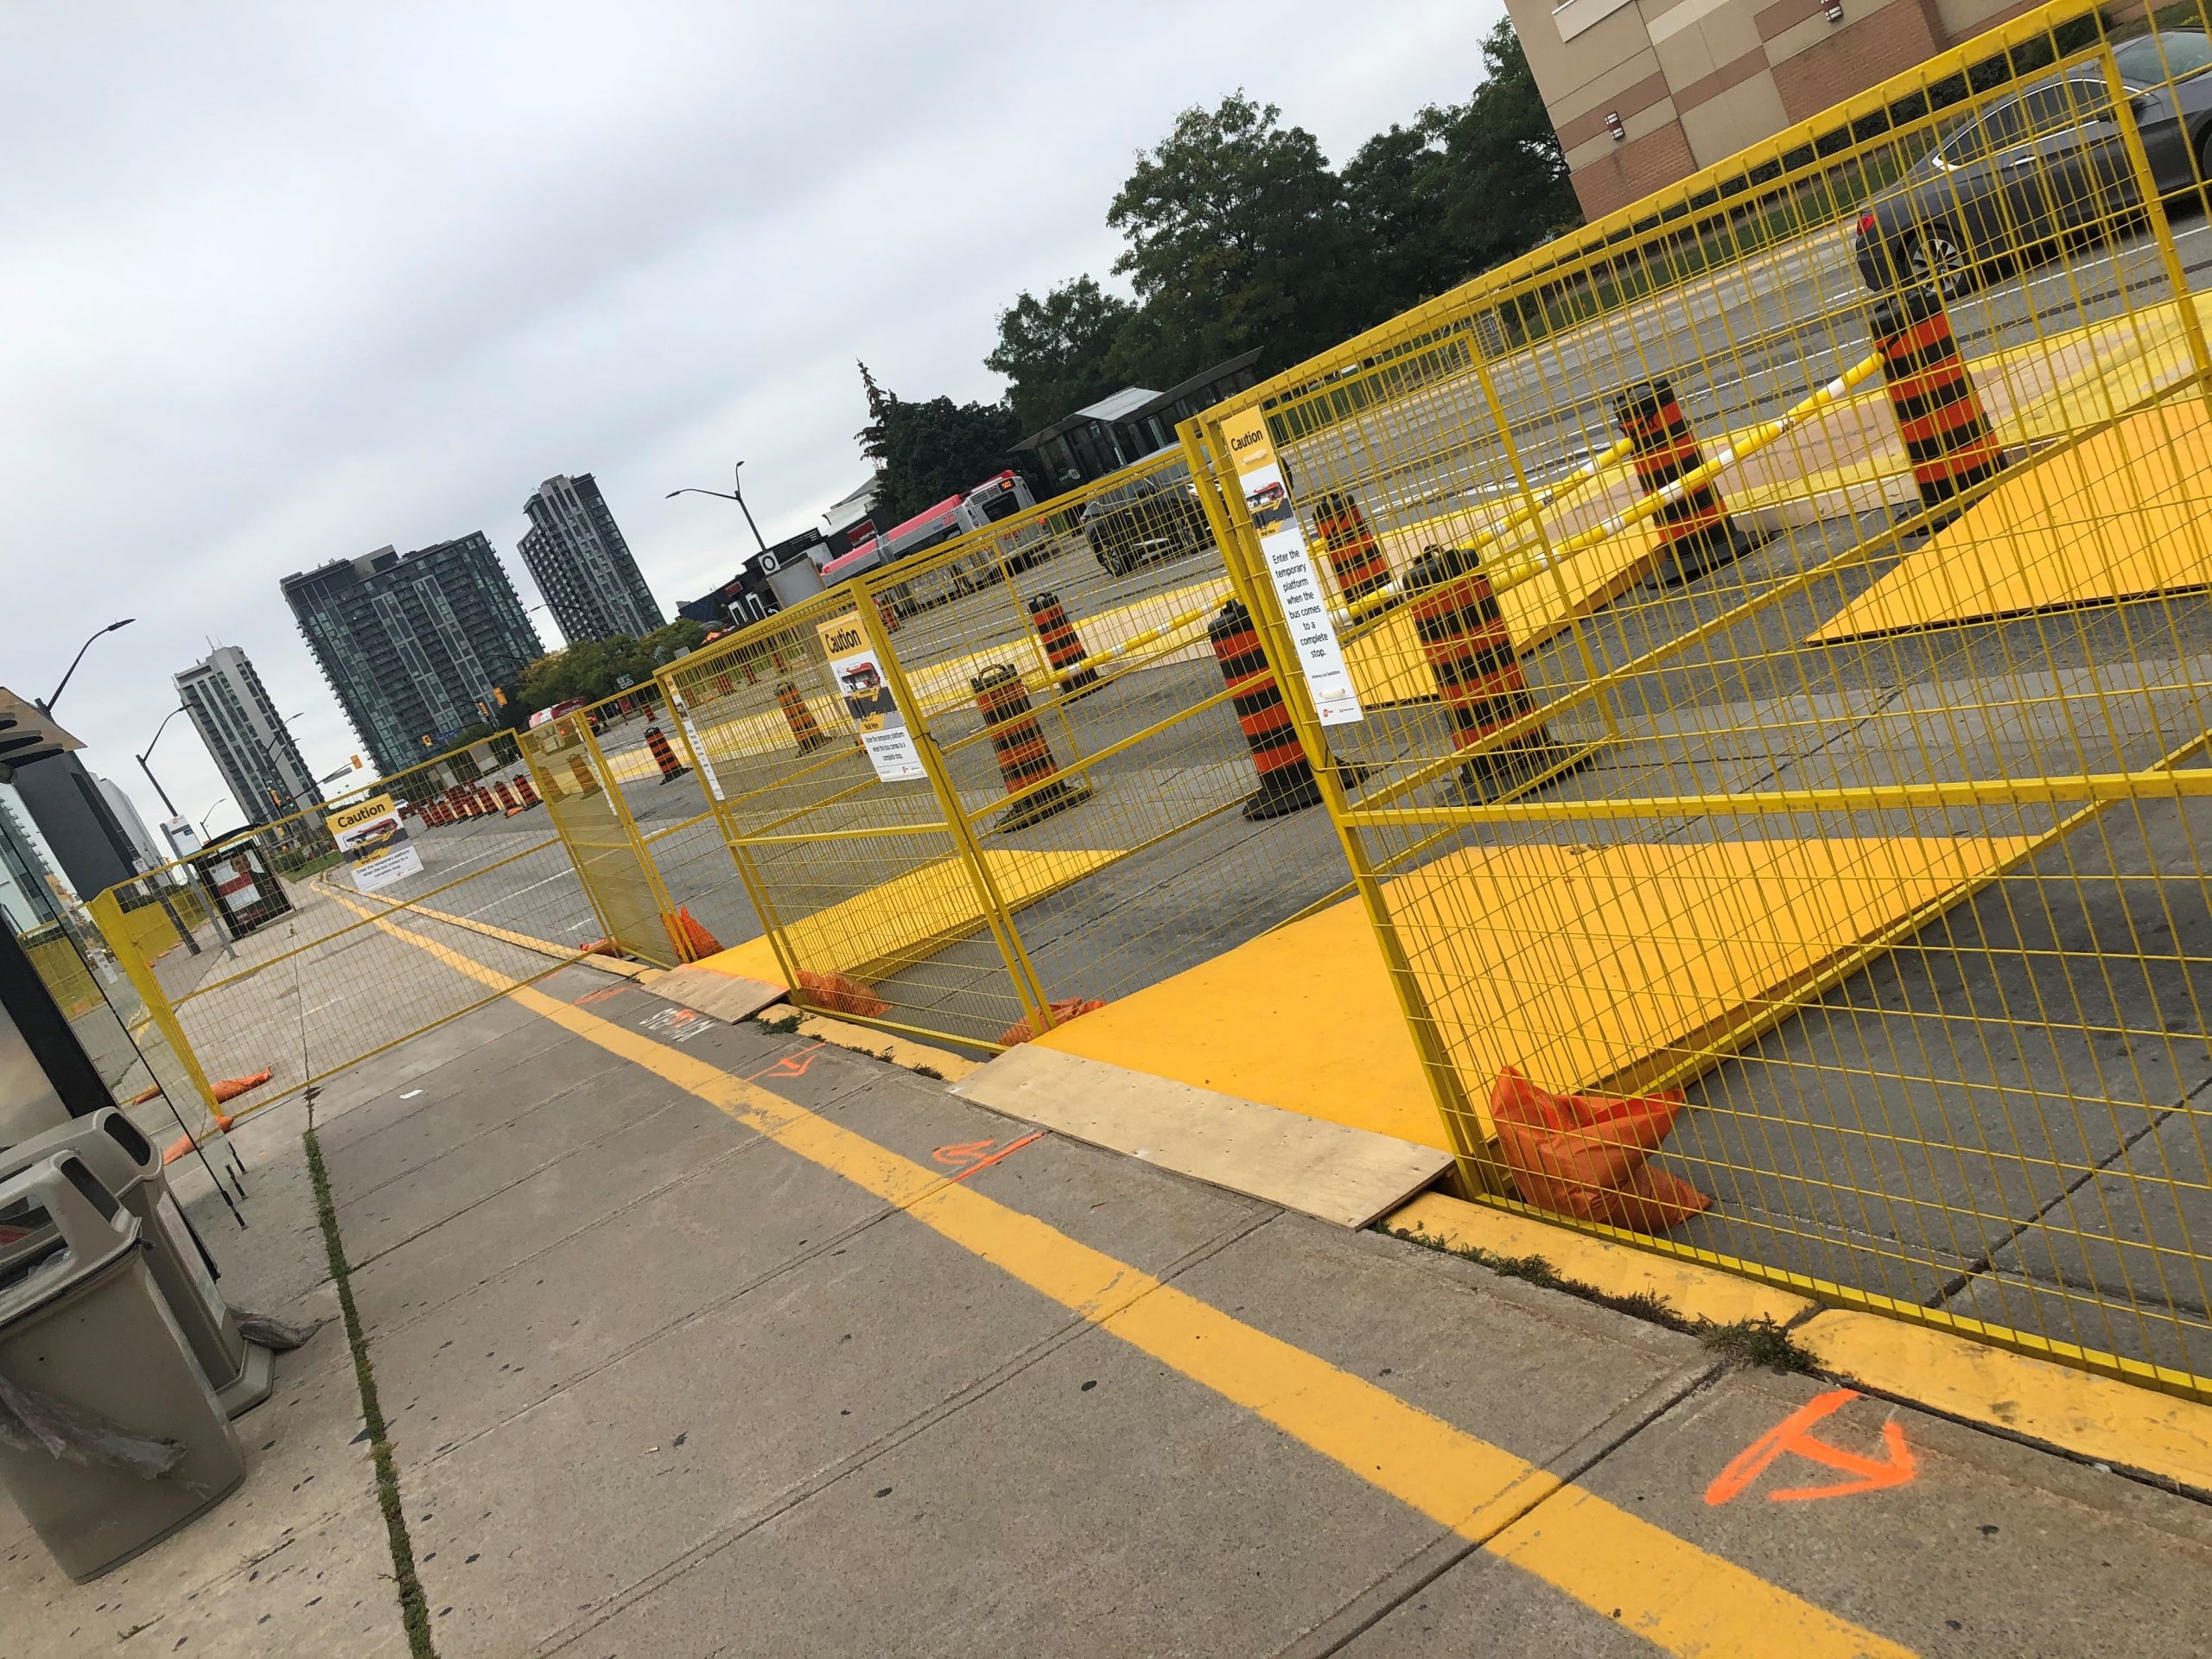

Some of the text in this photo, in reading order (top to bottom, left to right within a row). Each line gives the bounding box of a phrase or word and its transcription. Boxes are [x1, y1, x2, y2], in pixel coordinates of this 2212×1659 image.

[1230, 429, 1264, 452] Caution
[1272, 550, 1300, 564] Enter the
[1275, 563, 1306, 579] temporary
[1282, 578, 1309, 593] platform
[1287, 591, 1314, 605] when the
[1288, 606, 1321, 620] bus comes
[1303, 622, 1311, 631] to
[825, 628, 862, 654] Caution
[1300, 632, 1329, 645] complete
[1311, 649, 1327, 658] stop.
[338, 804, 385, 828] Caution
